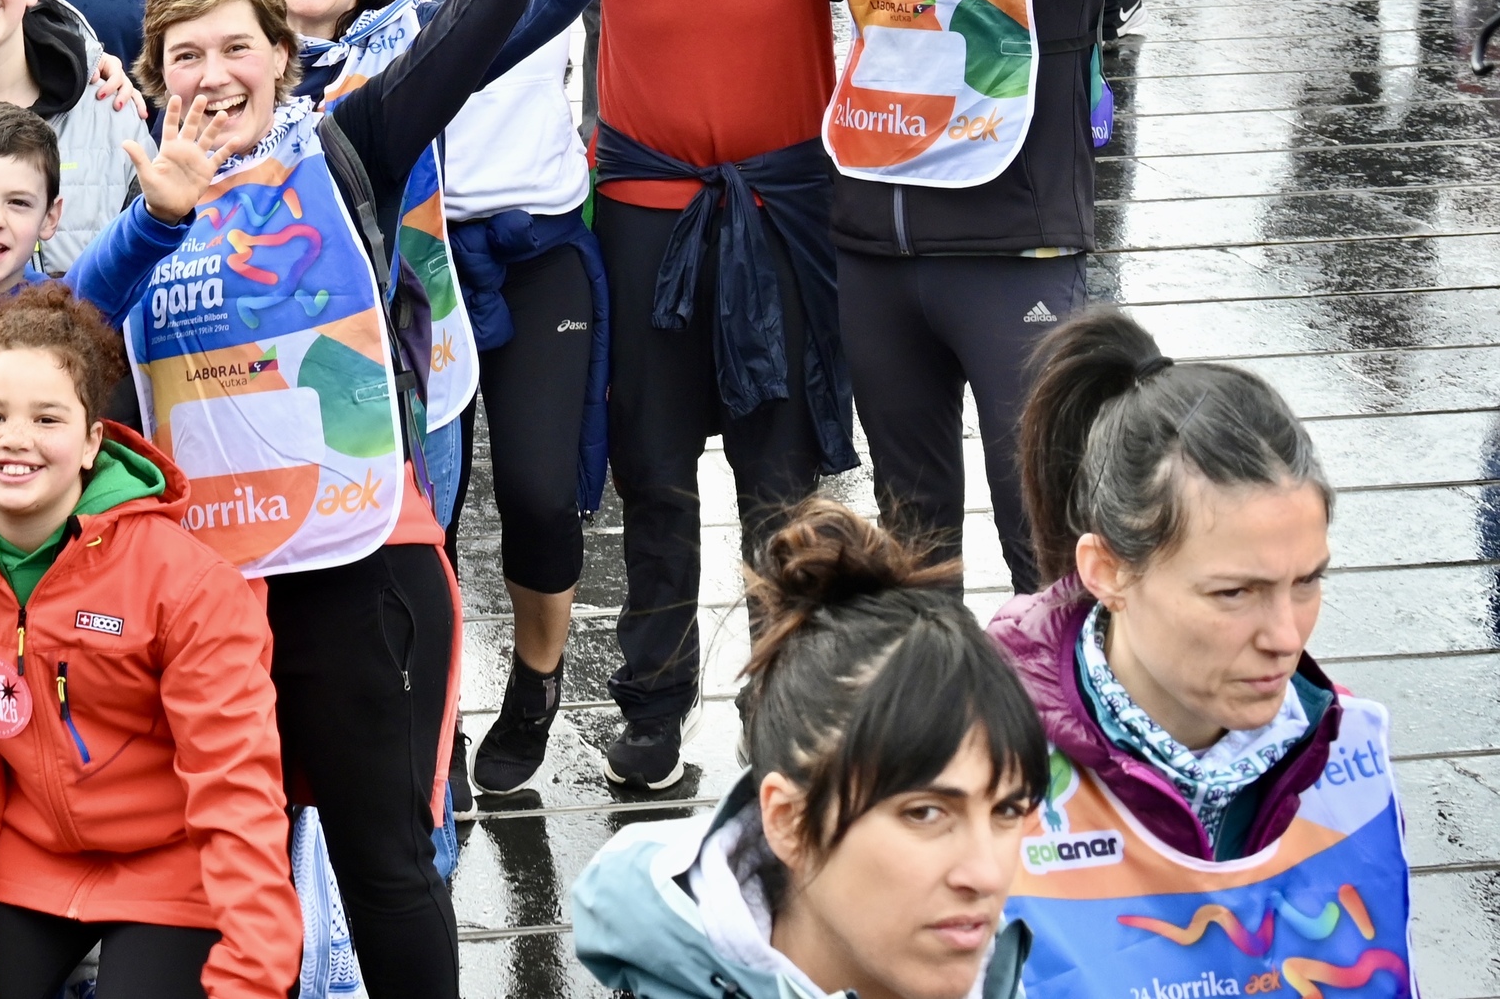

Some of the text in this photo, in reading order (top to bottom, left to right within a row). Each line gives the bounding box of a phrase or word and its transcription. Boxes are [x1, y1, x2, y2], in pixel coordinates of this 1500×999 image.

[833, 97, 1004, 142] 24.korrika aek
[148, 254, 222, 288] uskara
[152, 278, 224, 330] gara
[204, 312, 228, 323] Bilbora
[1023, 314, 1058, 323] adidas
[430, 328, 456, 373] ek
[185, 363, 246, 382] LABORAL
[180, 467, 383, 531] orrika aek
[93, 616, 119, 632] 8000
[1025, 835, 1118, 867] goiener
[1244, 969, 1281, 995] aek
